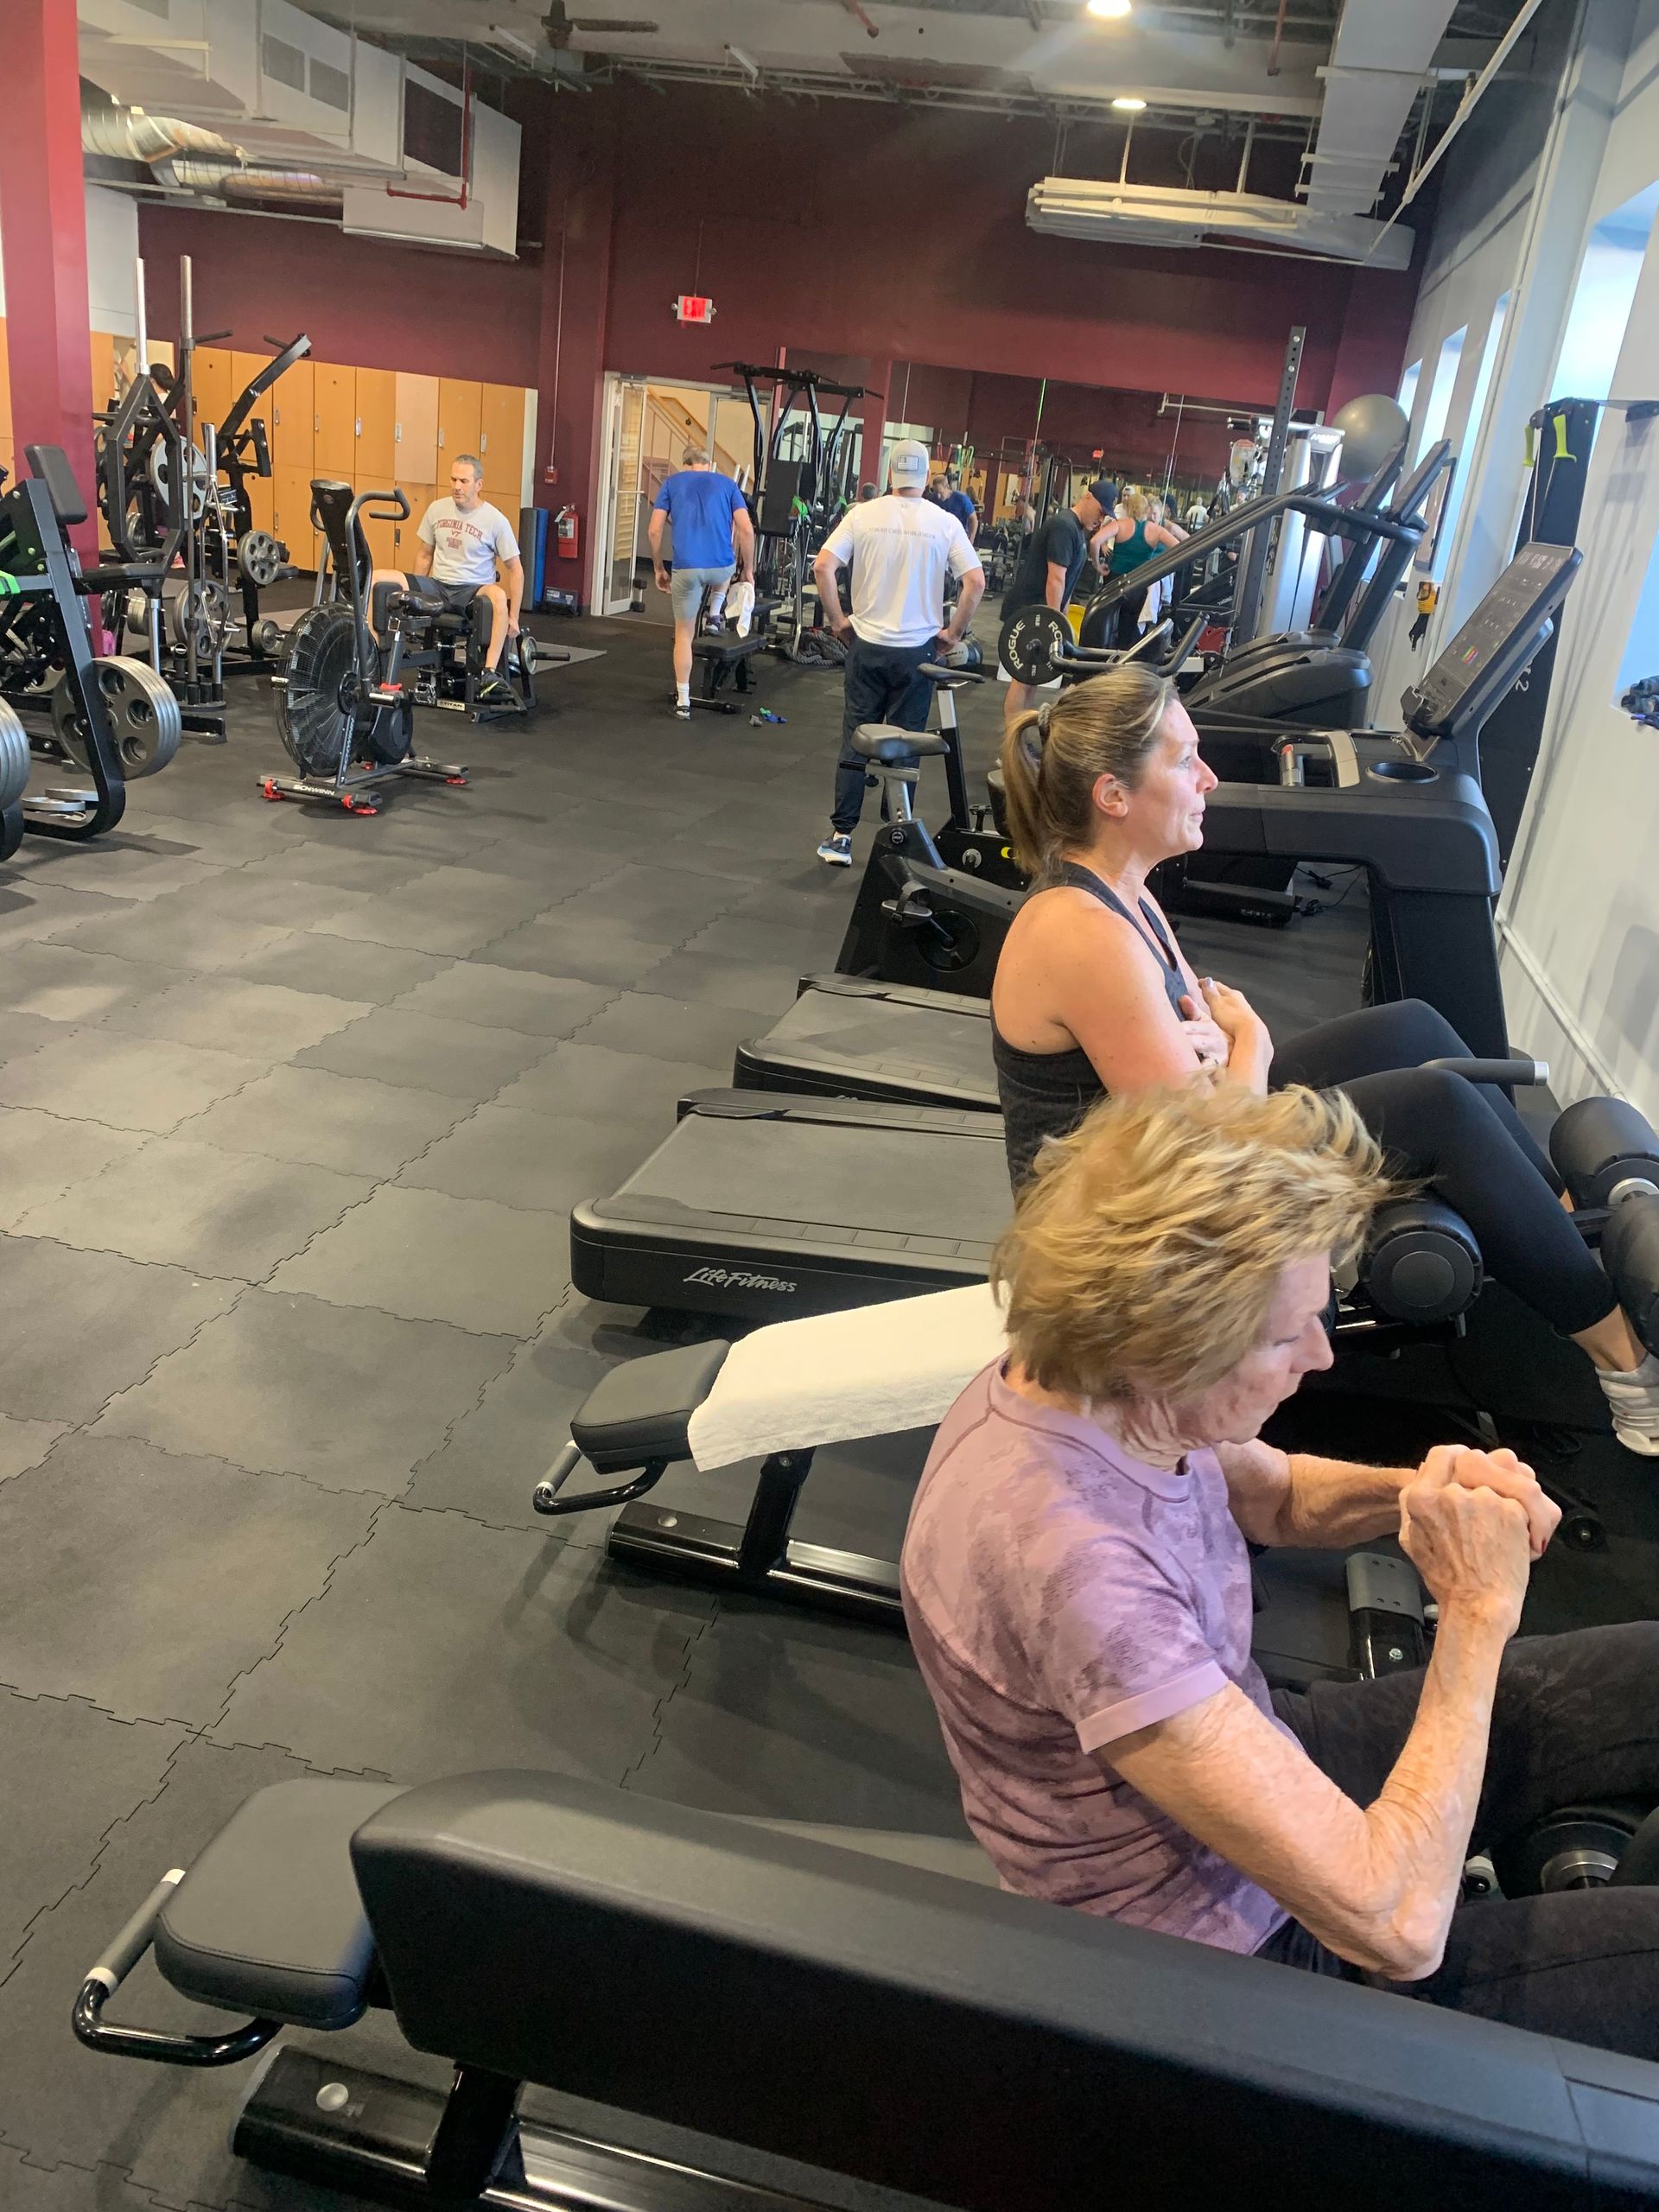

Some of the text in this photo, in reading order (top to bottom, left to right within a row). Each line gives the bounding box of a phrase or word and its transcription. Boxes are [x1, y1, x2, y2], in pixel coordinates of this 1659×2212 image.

[436, 518, 483, 540] VIRGINIA TECH
[1008, 620, 1026, 670] ROGUE
[293, 784, 335, 796] SCHWINN
